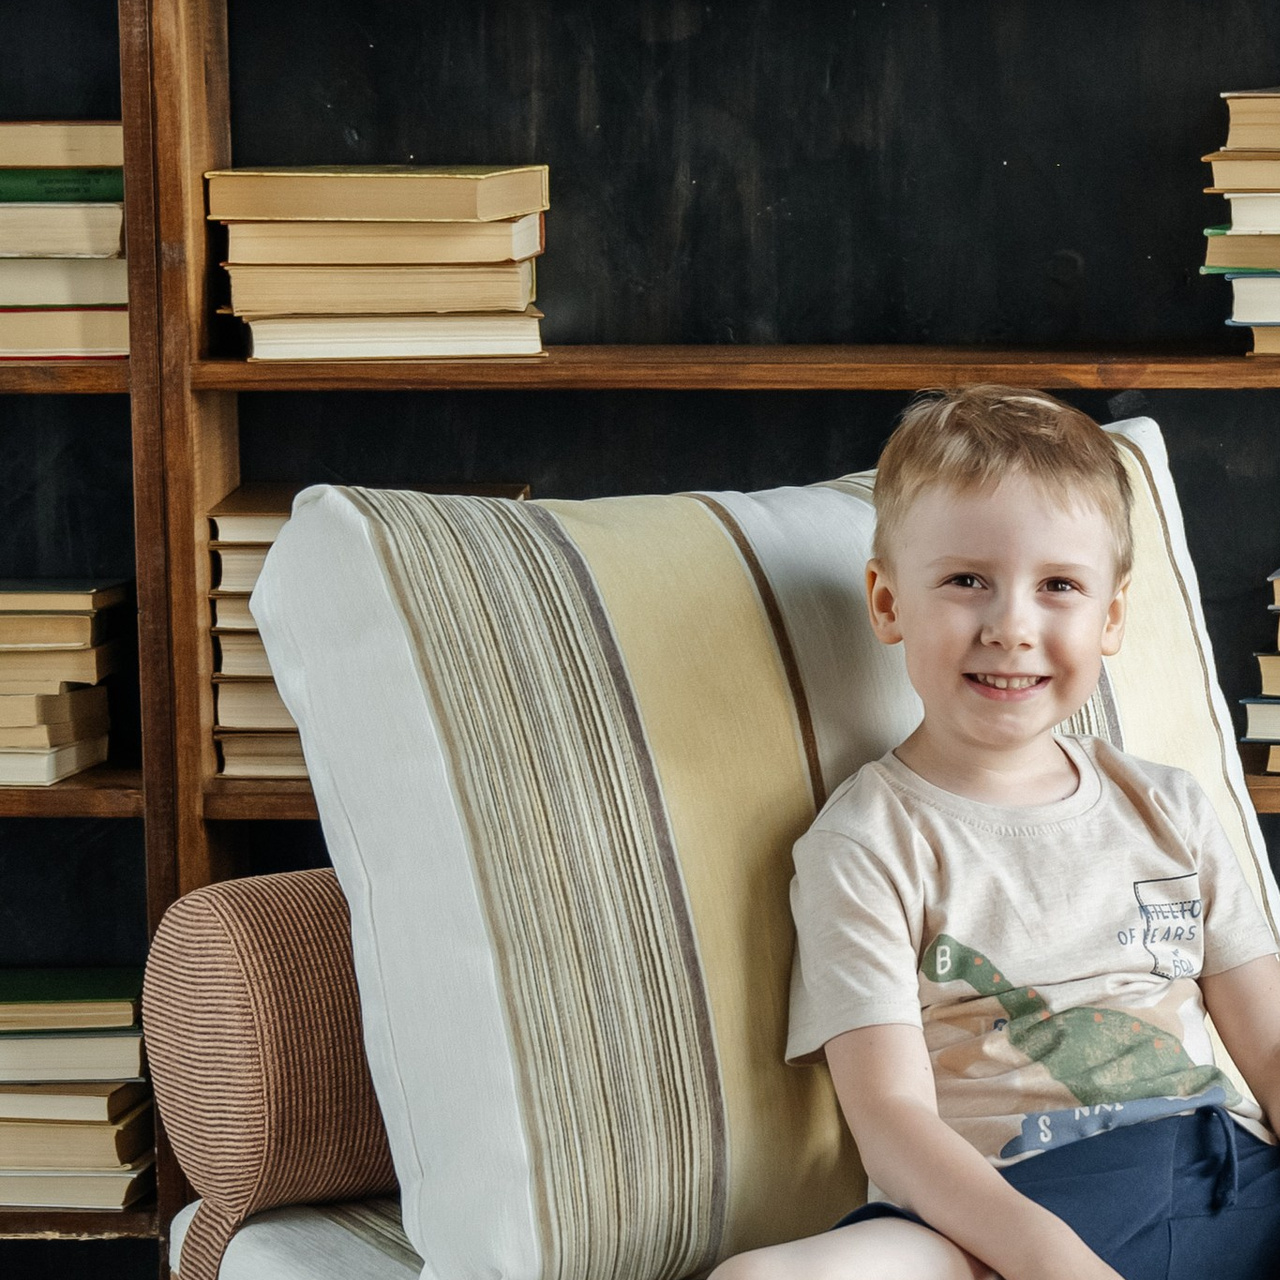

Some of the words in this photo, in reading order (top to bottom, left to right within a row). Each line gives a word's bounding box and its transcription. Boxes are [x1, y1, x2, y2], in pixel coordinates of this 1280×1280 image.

[1117, 928, 1136, 946] OF
[936, 945, 951, 975] B
[1038, 1115, 1052, 1143] S
